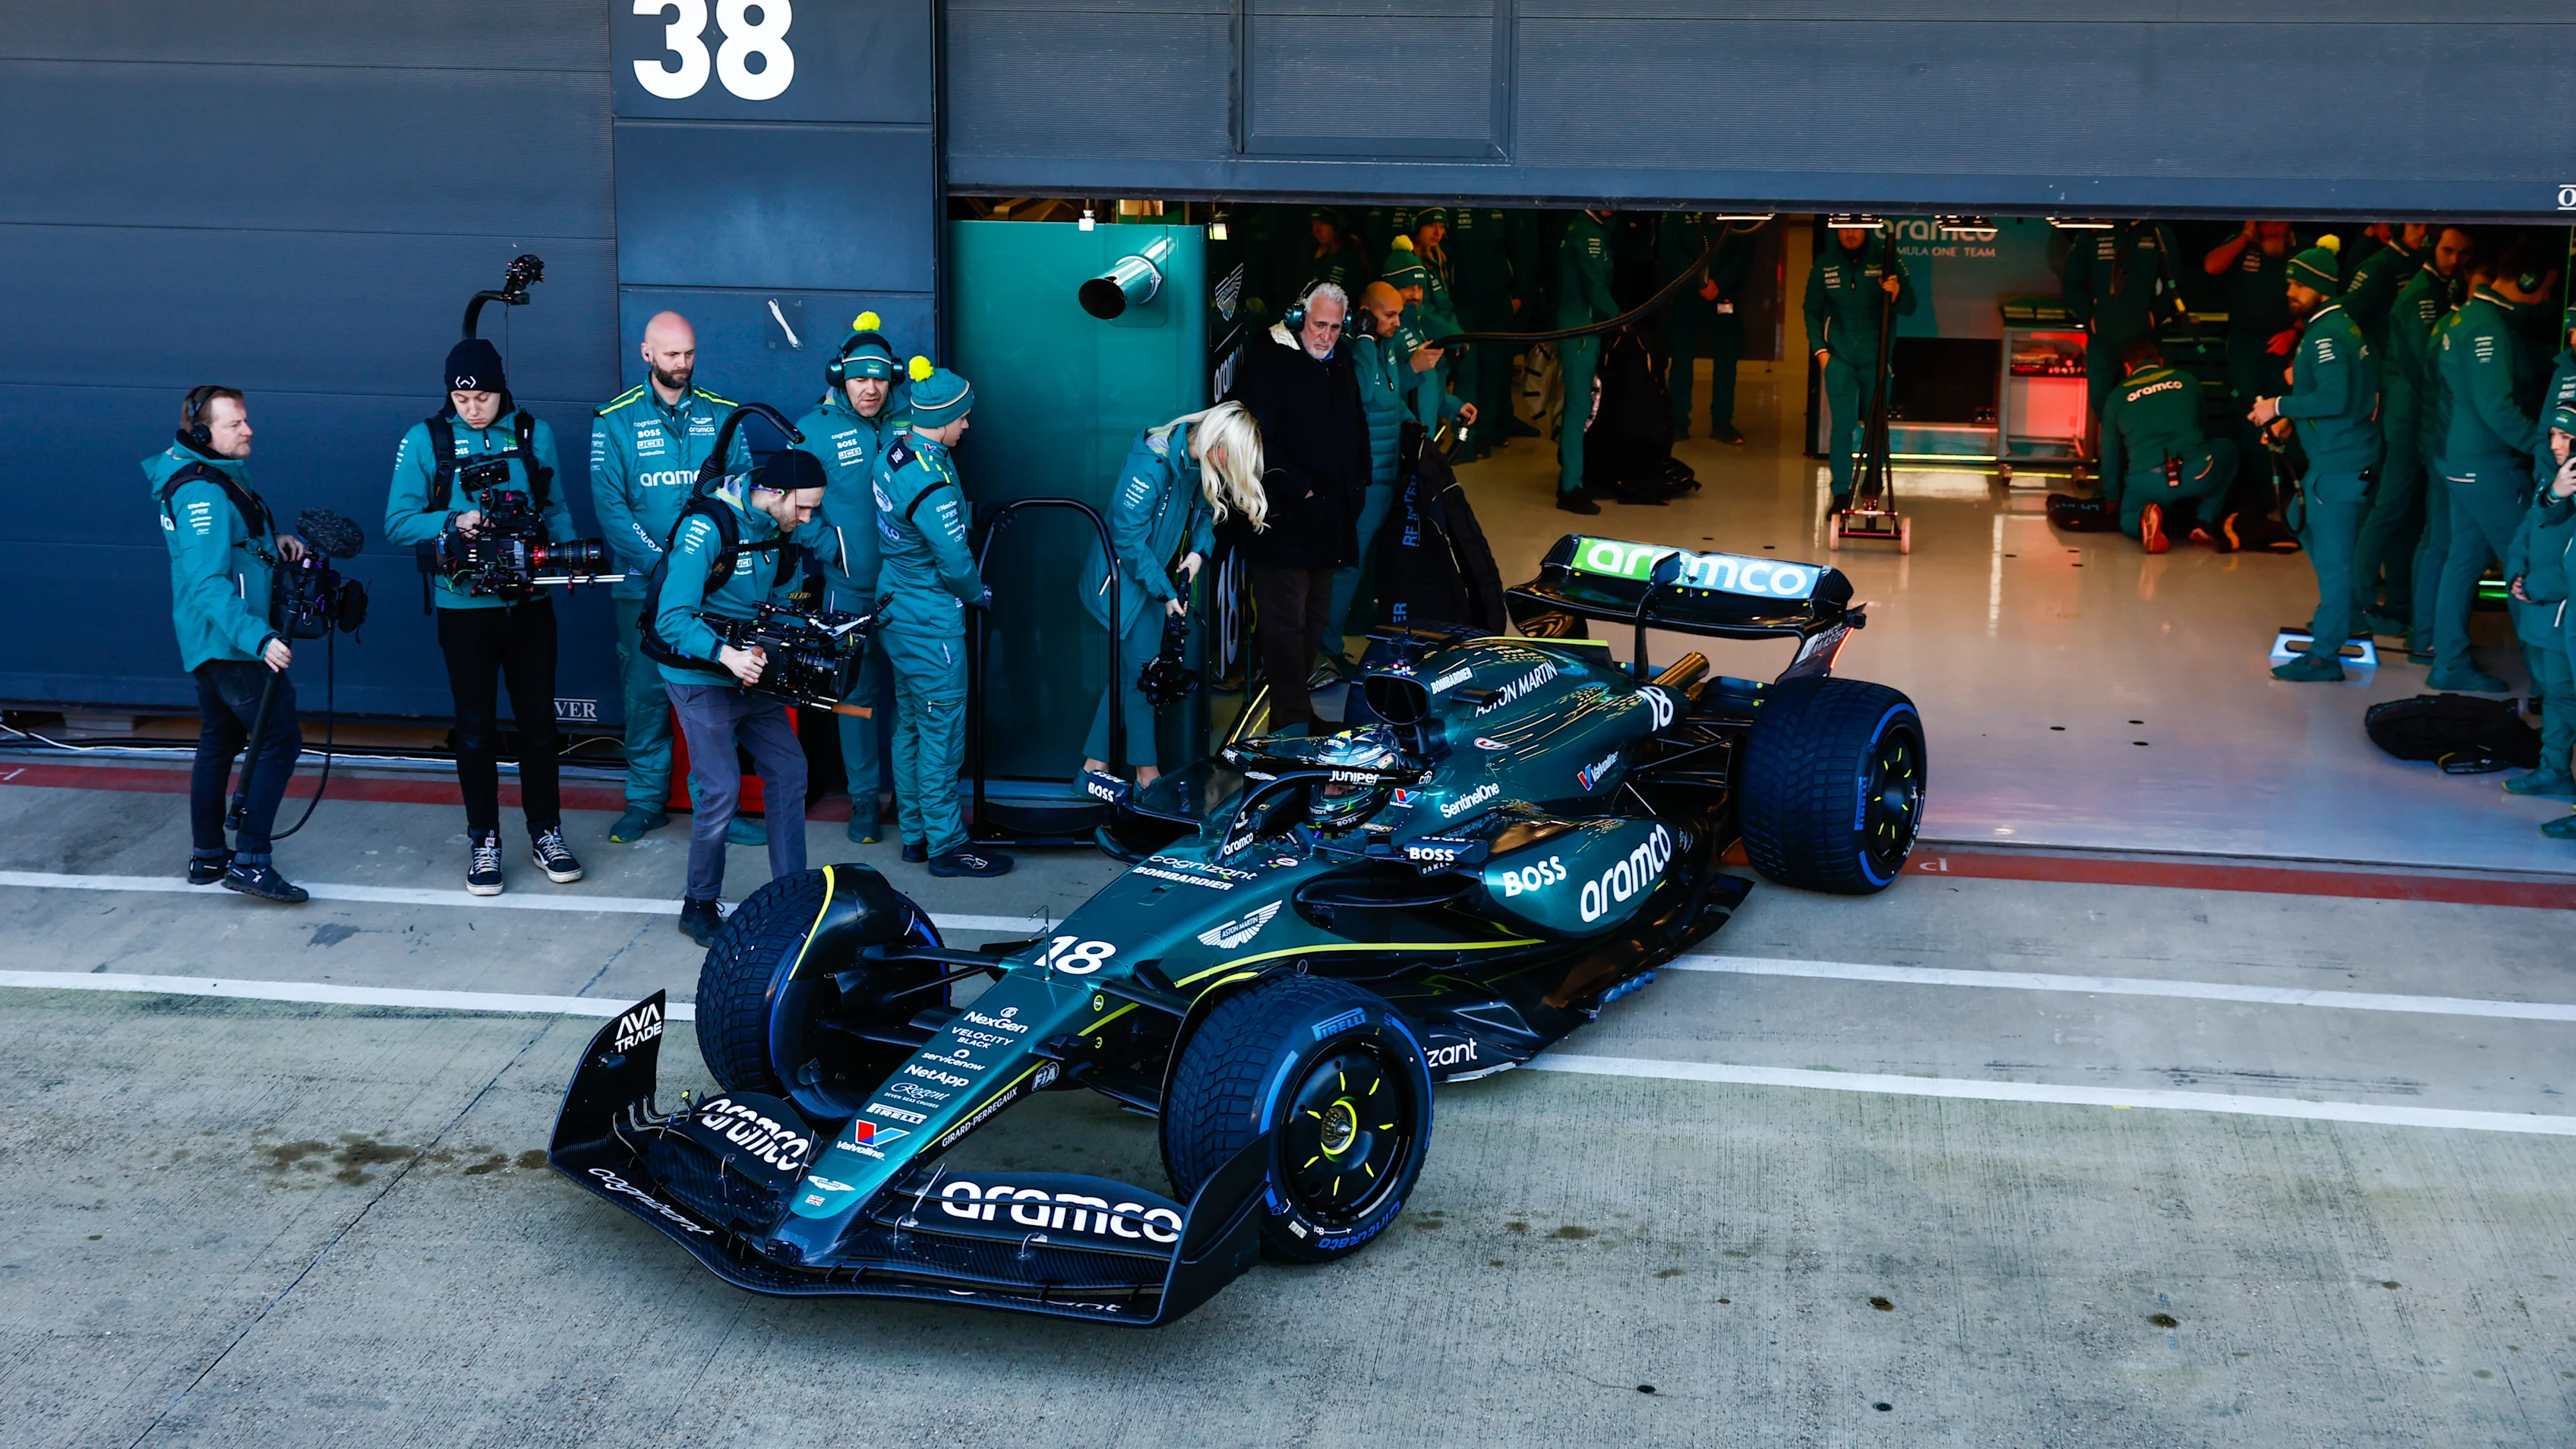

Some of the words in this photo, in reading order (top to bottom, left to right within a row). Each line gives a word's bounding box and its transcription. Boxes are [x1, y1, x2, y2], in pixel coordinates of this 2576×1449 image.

[632, 0, 795, 100] 38
[1932, 247, 1957, 257] ONE
[1964, 247, 1997, 257] TEAM
[2127, 380, 2182, 402] aramco
[637, 428, 661, 438] BOSS
[637, 438, 665, 449] JCB
[832, 428, 858, 440] cognizant
[836, 438, 857, 449] BOSS
[838, 447, 862, 459] JCB
[639, 470, 700, 487] aram
[1430, 666, 1473, 695] BOMBARDIER
[1518, 659, 1558, 697] MARTIN
[1635, 686, 1674, 731] 18
[1419, 771, 1433, 784] citi
[1590, 750, 1620, 783] Valvoline
[1088, 781, 1114, 803] BOSS
[1440, 782, 1500, 819] SentinelOne
[1337, 816, 1357, 827] BOSS
[1223, 832, 1254, 855] aramco
[1409, 847, 1455, 862] BOSS
[1132, 866, 1234, 892] BOMBARDIER
[1149, 855, 1259, 880] cognizant
[1502, 855, 1567, 898] BOSS
[1580, 823, 1672, 923] aramco
[1221, 923, 1239, 939] ASTON
[1239, 915, 1259, 933] MARTIN
[1034, 935, 1116, 975] 18
[616, 1002, 661, 1040] AVA
[963, 1011, 1028, 1034] NexGen
[1311, 1007, 1366, 1041] PIRELLI
[614, 1021, 662, 1053] TRADE
[952, 1026, 1014, 1046] VELOCITY
[957, 1037, 991, 1050] BLACK
[921, 1052, 986, 1072] servicenow
[904, 1064, 969, 1088] NetApp
[891, 1082, 950, 1101] Regent
[866, 1102, 928, 1125] PIRELLI
[916, 1099, 939, 1109] CRUISES
[942, 1086, 1018, 1148] GIRARD-PERREGAUX
[701, 1098, 810, 1171] aramco
[836, 1141, 885, 1160] Valvoline
[588, 1168, 715, 1236] cognizant
[941, 1181, 1183, 1243] aramco
